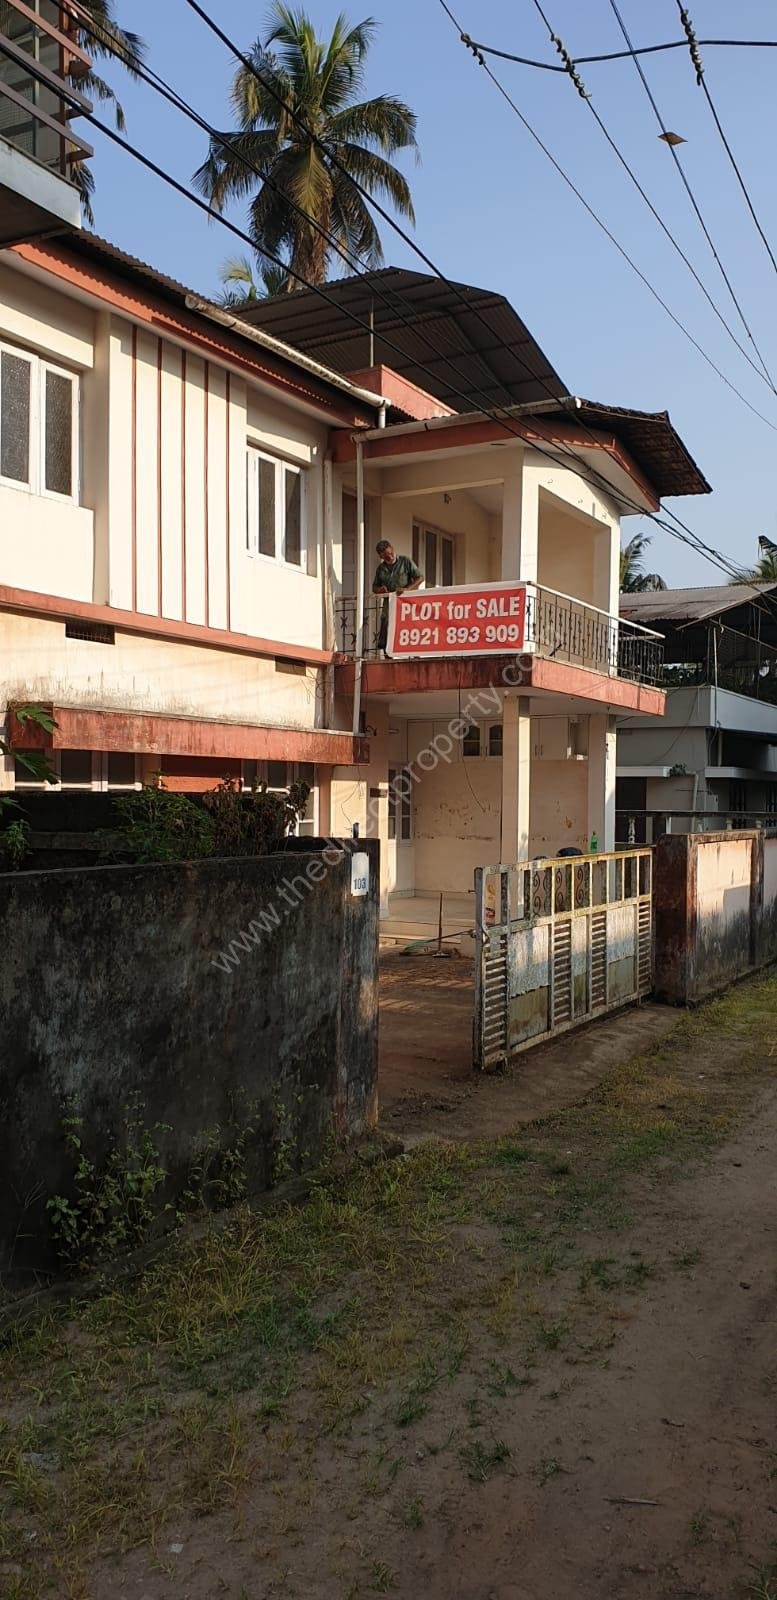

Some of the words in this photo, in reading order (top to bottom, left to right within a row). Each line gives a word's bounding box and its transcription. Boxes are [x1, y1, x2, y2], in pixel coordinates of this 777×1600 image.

[401, 602, 442, 621] PLOT
[447, 601, 472, 620] for
[476, 597, 520, 619] SALE
[399, 628, 439, 646] 8921
[446, 626, 480, 644] 893
[485, 624, 519, 643] 909
[354, 878, 366, 890] 103
